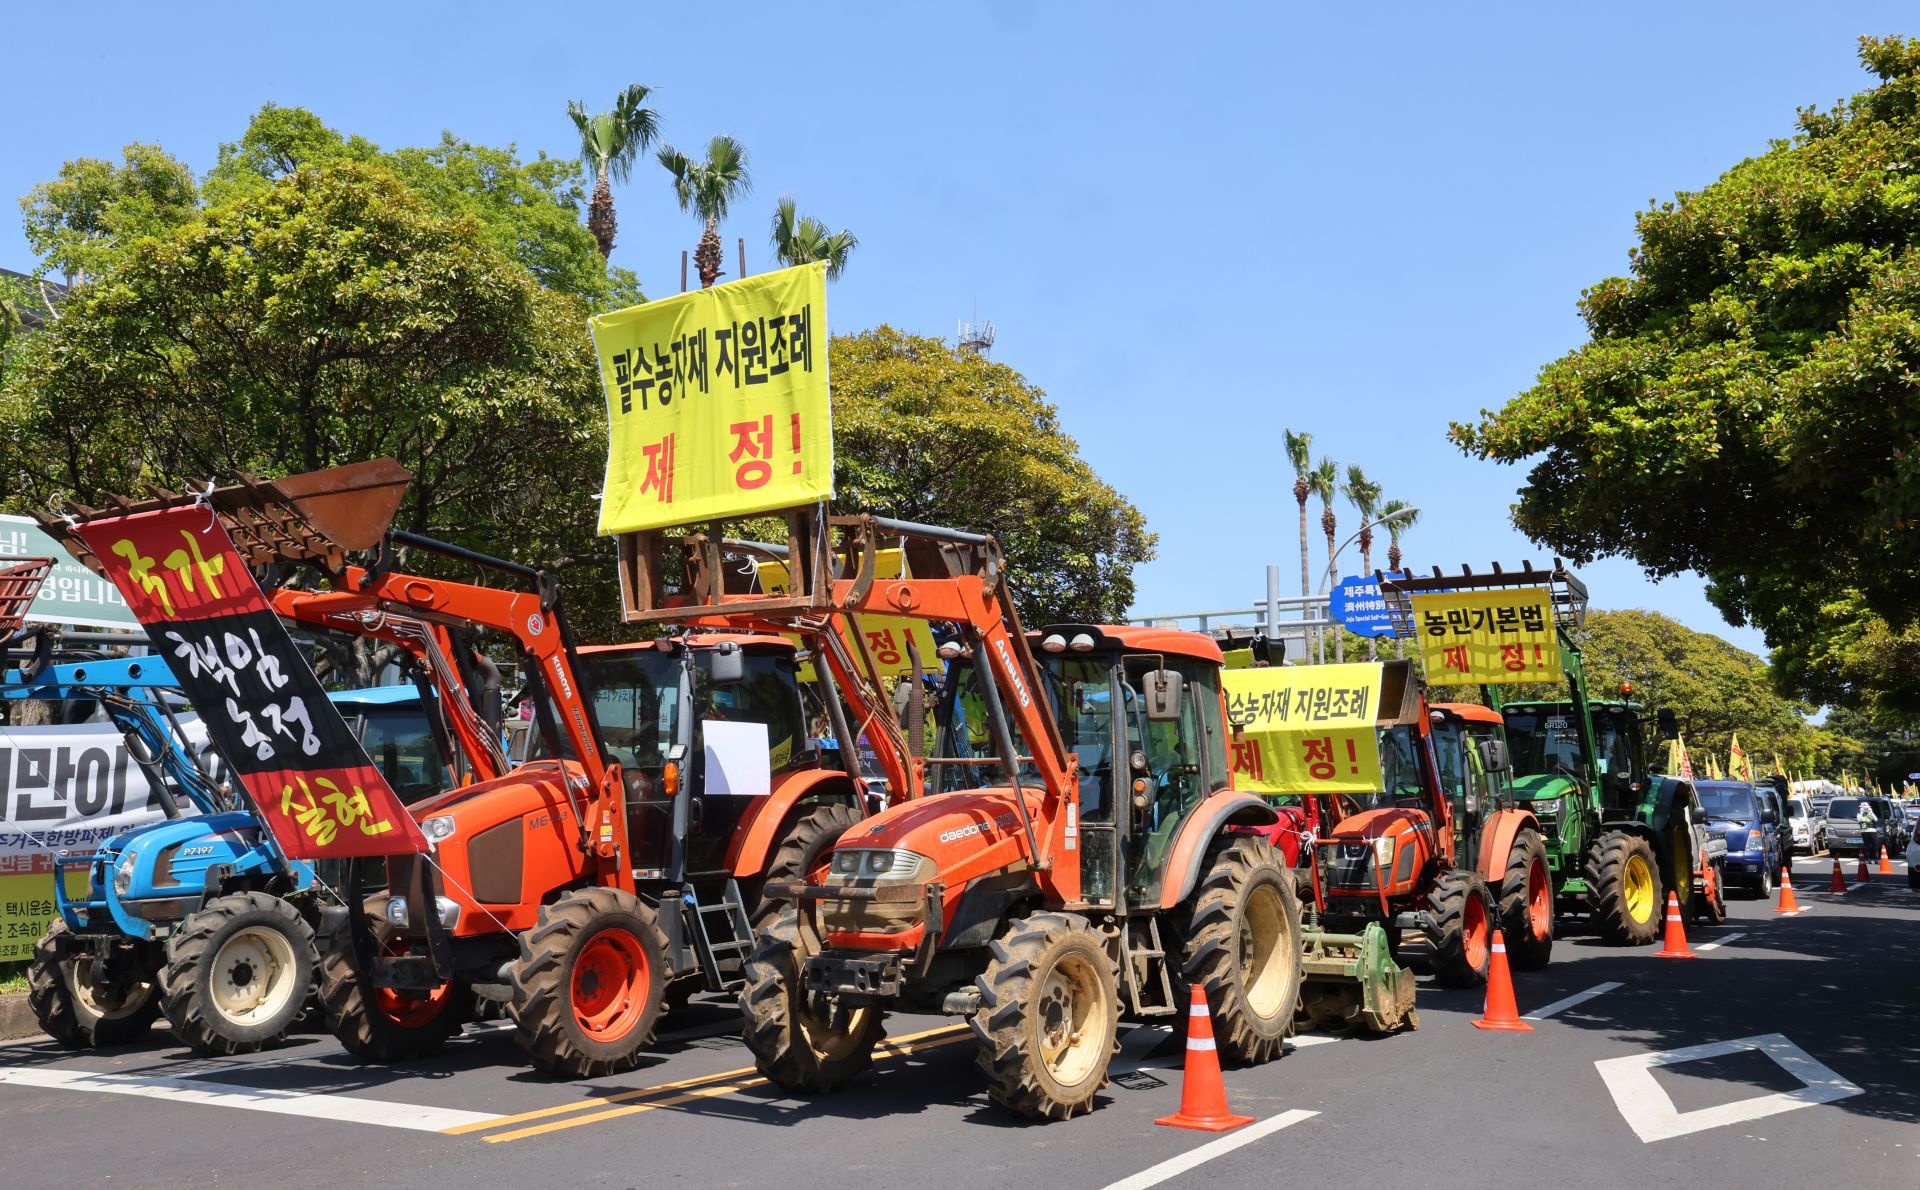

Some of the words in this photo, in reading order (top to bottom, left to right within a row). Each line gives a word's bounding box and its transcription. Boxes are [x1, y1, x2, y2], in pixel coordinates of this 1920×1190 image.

[613, 327, 709, 414] 필수농자재
[715, 304, 813, 388] 지원조례
[640, 432, 675, 503] 제
[112, 529, 224, 617] 국가
[1344, 585, 1383, 597] 제주특별
[1345, 600, 1387, 612] 濟州特別
[1424, 605, 1544, 636] 농민기본법
[165, 628, 289, 697] 책임
[552, 655, 573, 699] KUBOTA
[995, 640, 1030, 708] Ansung
[1443, 645, 1470, 673] 제
[1227, 687, 1291, 724] 수농자재
[1295, 686, 1369, 721] 지원조례
[226, 696, 321, 761] 농정
[1231, 739, 1263, 781] 제
[281, 776, 393, 846] 실현
[6, 899, 61, 918] 택시운송
[0, 944, 18, 956] 조합
[7, 921, 40, 939] 조속히
